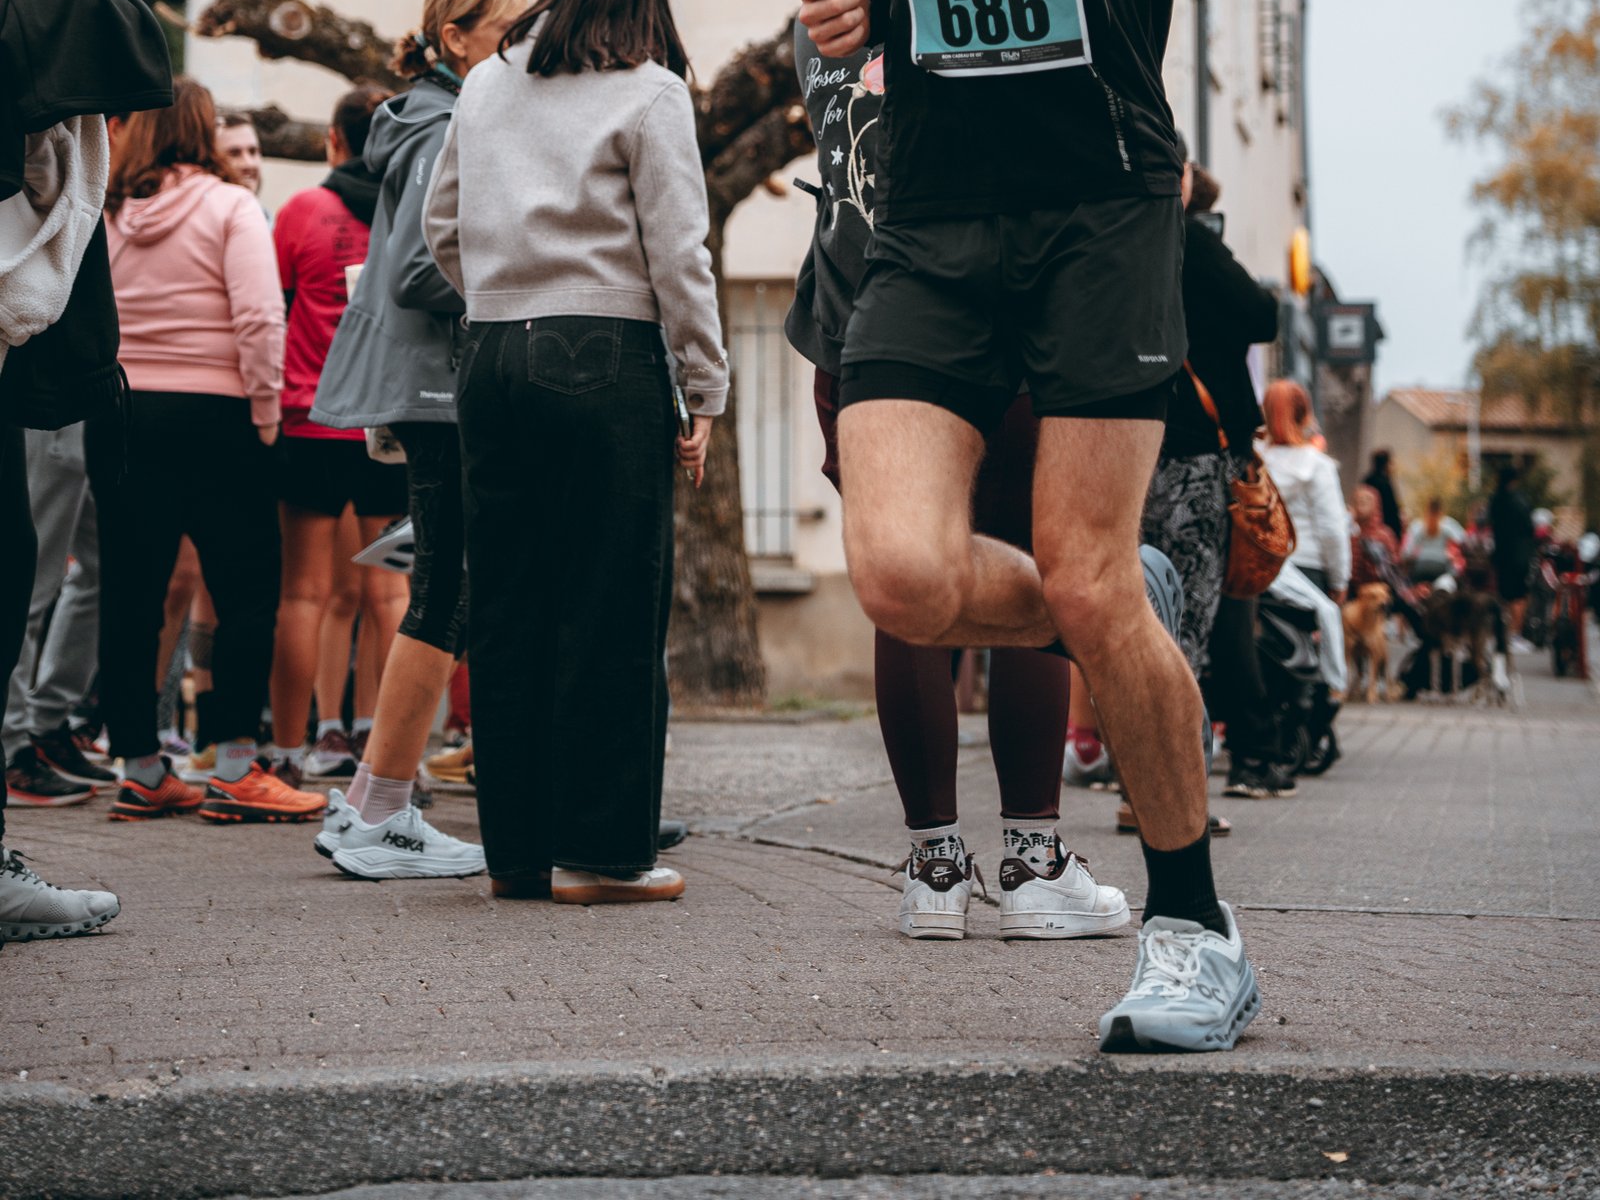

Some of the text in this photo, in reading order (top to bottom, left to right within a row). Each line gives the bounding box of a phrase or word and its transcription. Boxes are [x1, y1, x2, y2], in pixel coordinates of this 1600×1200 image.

[805, 57, 850, 99] Roses
[818, 94, 846, 140] for
[382, 830, 424, 853] HOKA
